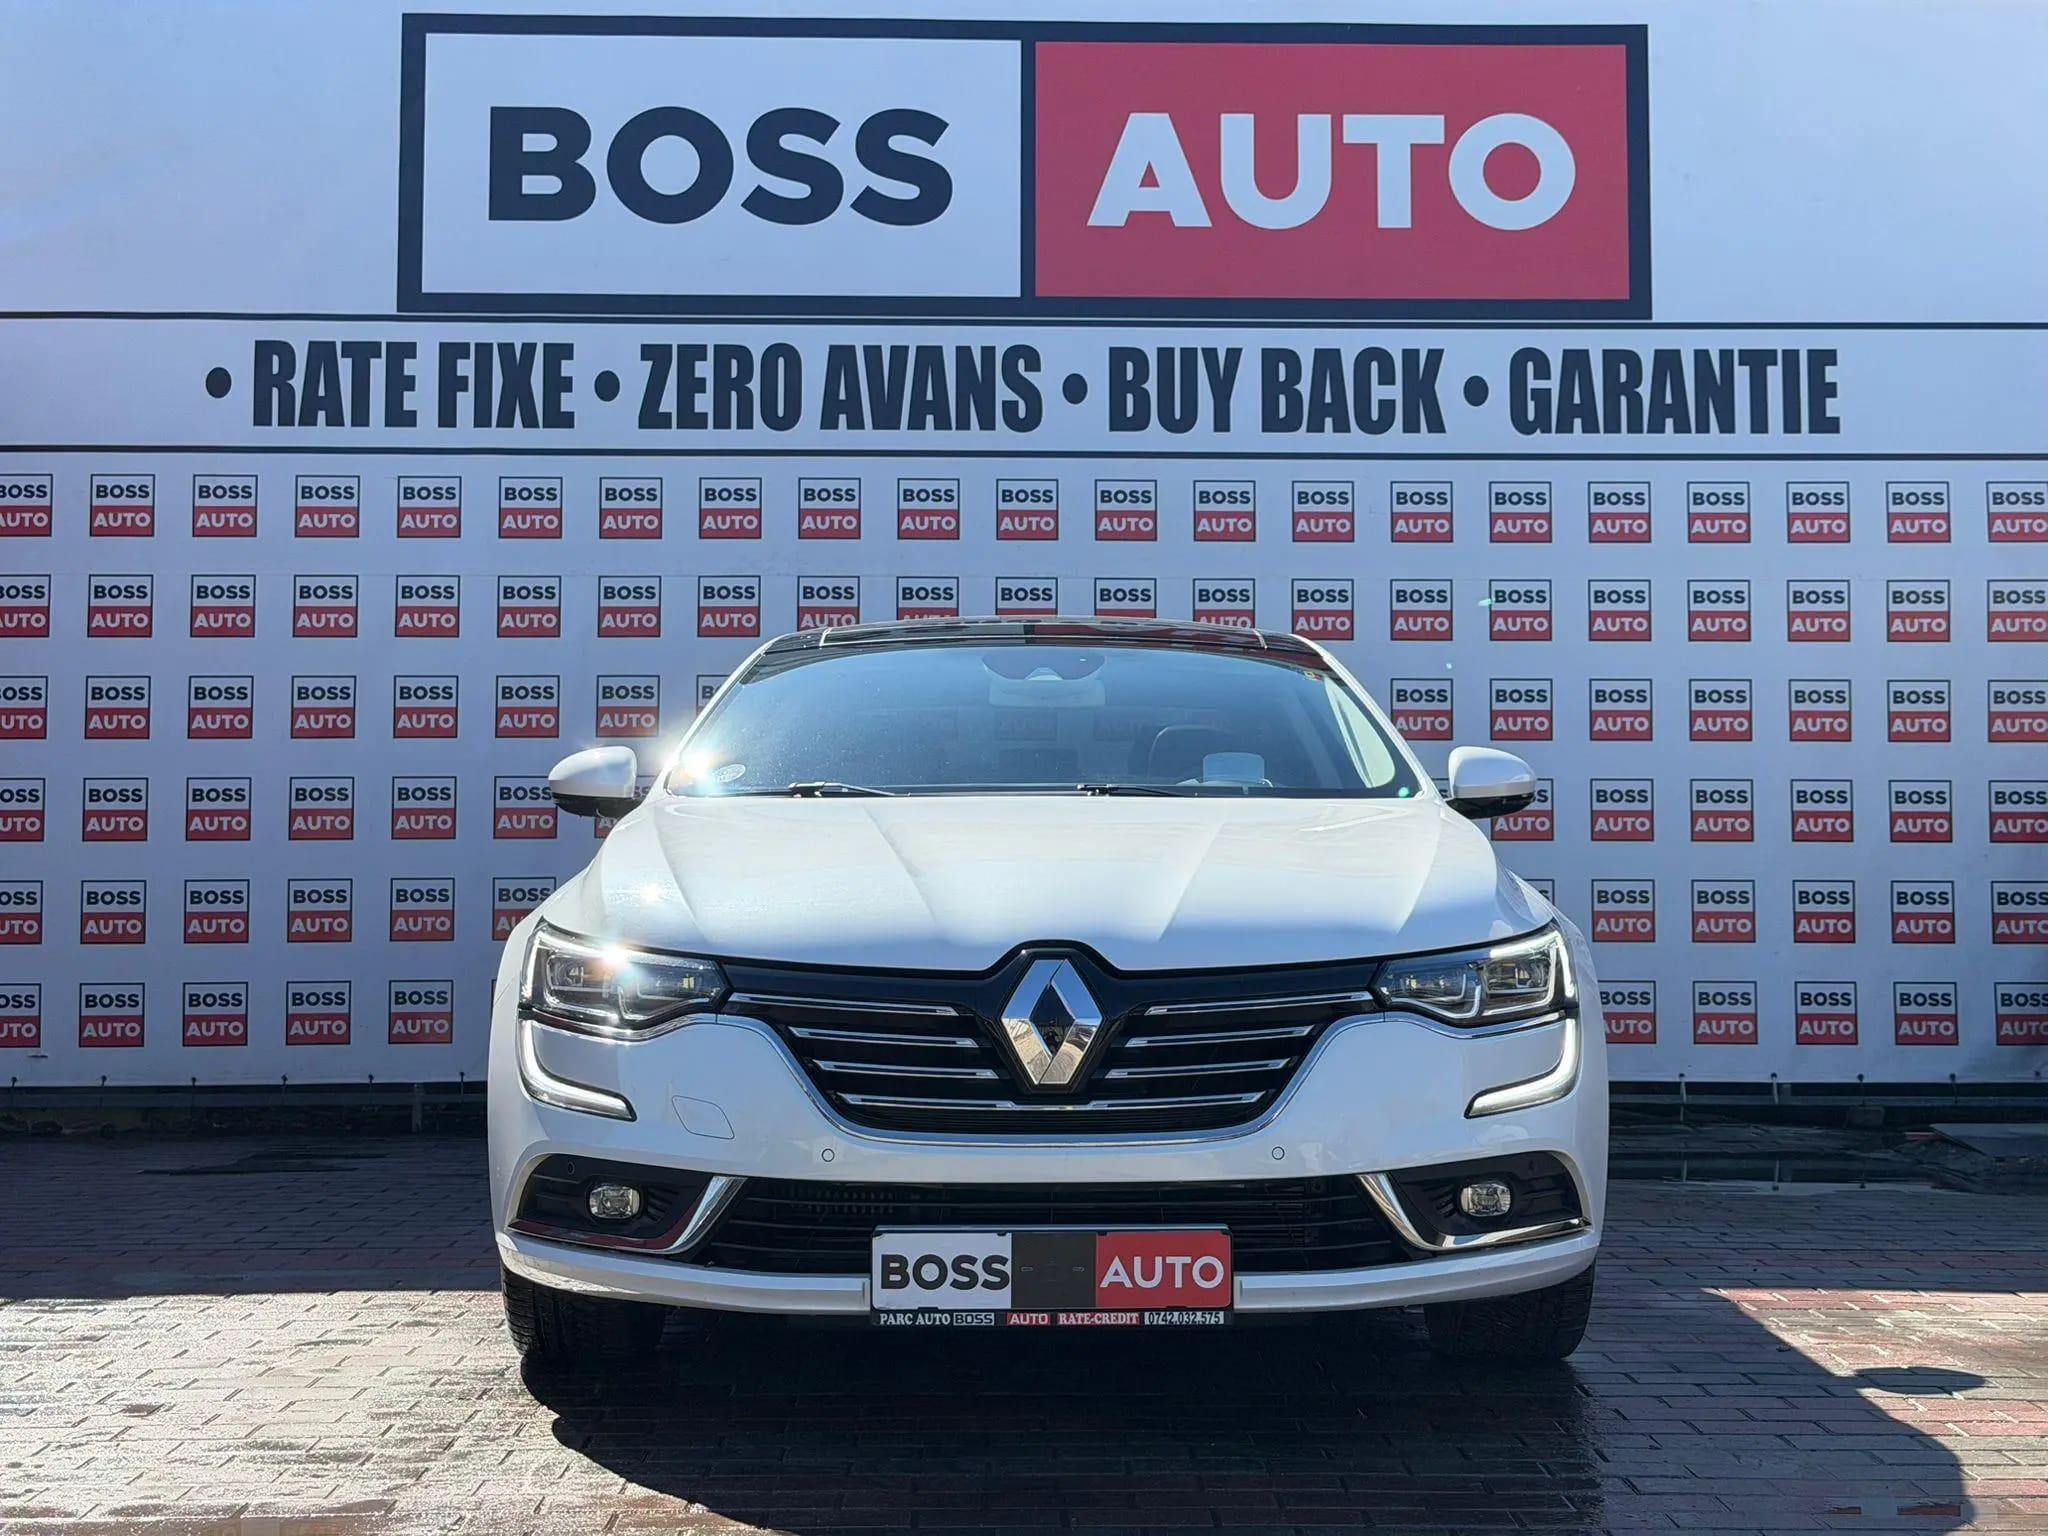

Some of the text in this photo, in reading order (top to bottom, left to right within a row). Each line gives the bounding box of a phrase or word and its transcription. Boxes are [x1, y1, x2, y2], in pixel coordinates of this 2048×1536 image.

[488, 106, 1576, 231] BOSS AUTO
[252, 340, 1842, 435] RATE FIXE ZERO AVANS BUY BACK GARANTIE
[95, 484, 150, 499] BOSS
[198, 484, 253, 500] BOSS
[403, 486, 457, 501] BOSS
[504, 486, 558, 502] BOSS
[604, 487, 658, 502] BOSS
[704, 487, 757, 502] BOSS
[803, 487, 856, 502] BOSS
[1001, 489, 1054, 504] BOSS
[1100, 489, 1153, 504] BOSS
[1198, 490, 1251, 505] BOSS
[1297, 490, 1350, 505] BOSS
[1395, 491, 1449, 506] BOSS
[1494, 491, 1547, 506] BOSS
[1593, 491, 1646, 506] BOSS
[1791, 491, 1845, 506] BOSS
[1891, 491, 1945, 506] BOSS
[1992, 491, 2046, 506] BOSS
[93, 512, 151, 527] AUTO
[196, 513, 254, 528] AUTO
[400, 514, 458, 529] AUTO
[502, 514, 559, 529] AUTO
[602, 515, 659, 530] AUTO
[702, 515, 758, 530] AUTO
[801, 515, 858, 530] AUTO
[999, 516, 1055, 531] AUTO
[1098, 517, 1154, 532] AUTO
[1197, 518, 1253, 533] AUTO
[1296, 518, 1351, 533] AUTO
[1394, 519, 1450, 534] AUTO
[1493, 519, 1549, 534] AUTO
[1592, 519, 1648, 534] AUTO
[1790, 519, 1847, 534] AUTO
[1890, 519, 1948, 534] AUTO
[93, 584, 148, 600] BOSS
[196, 584, 251, 600] BOSS
[299, 585, 353, 600] BOSS
[401, 585, 455, 600] BOSS
[603, 585, 657, 600] BOSS
[703, 585, 756, 600] BOSS
[802, 585, 855, 600] BOSS
[901, 586, 954, 601] BOSS
[1000, 587, 1053, 602] BOSS
[1099, 587, 1152, 603] BOSS
[1198, 588, 1251, 603] BOSS
[1296, 588, 1349, 603] BOSS
[1395, 589, 1448, 604] BOSS
[1494, 589, 1547, 604] BOSS
[1593, 589, 1646, 604] BOSS
[1792, 590, 1845, 605] BOSS
[1891, 590, 1945, 605] BOSS
[1992, 589, 2046, 605] BOSS
[91, 613, 149, 628] AUTO
[194, 613, 252, 628] AUTO
[296, 613, 354, 628] AUTO
[398, 613, 456, 628] AUTO
[601, 613, 657, 628] AUTO
[701, 613, 757, 628] AUTO
[1295, 616, 1351, 632] AUTO
[1394, 617, 1450, 632] AUTO
[1493, 617, 1549, 632] AUTO
[1592, 617, 1648, 632] AUTO
[1791, 617, 1847, 633] AUTO
[1890, 618, 1947, 633] AUTO
[1991, 617, 2048, 633] AUTO
[91, 686, 146, 701] BOSS
[297, 686, 351, 701] BOSS
[399, 685, 454, 700] BOSS
[501, 685, 555, 700] BOSS
[601, 685, 655, 700] BOSS
[1396, 688, 1449, 703] BOSS
[1495, 688, 1548, 703] BOSS
[1594, 689, 1648, 704] BOSS
[1694, 689, 1747, 704] BOSS
[1794, 689, 1847, 704] BOSS
[1892, 690, 1946, 705] BOSS
[1993, 690, 2047, 705] BOSS
[88, 714, 147, 730] AUTO
[294, 714, 352, 729] AUTO
[397, 713, 455, 729] AUTO
[498, 713, 556, 729] AUTO
[599, 713, 656, 729] AUTO
[1493, 716, 1550, 732] AUTO
[1593, 716, 1649, 732] AUTO
[1692, 717, 1749, 732] AUTO
[1792, 717, 1849, 732] AUTO
[1891, 718, 1948, 733] AUTO
[88, 788, 143, 803] BOSS
[191, 787, 246, 803] BOSS
[294, 787, 349, 802] BOSS
[397, 786, 452, 802] BOSS
[1595, 789, 1649, 804] BOSS
[1695, 789, 1749, 804] BOSS
[1796, 789, 1848, 804] BOSS
[1894, 790, 1947, 805] BOSS
[1994, 790, 2048, 805] BOSS
[86, 816, 144, 832] AUTO
[189, 816, 247, 831] AUTO
[292, 815, 351, 831] AUTO
[394, 815, 453, 830] AUTO
[497, 814, 554, 829] AUTO
[1494, 816, 1551, 832] AUTO
[1594, 817, 1651, 832] AUTO
[1694, 817, 1751, 832] AUTO
[1795, 817, 1850, 833] AUTO
[1893, 818, 1949, 833] AUTO
[86, 890, 141, 906] BOSS
[189, 889, 245, 905] BOSS
[395, 888, 450, 903] BOSS
[1597, 889, 1650, 904] BOSS
[1696, 890, 1750, 905] BOSS
[1798, 890, 1850, 905] BOSS
[1896, 891, 1950, 906] BOSS
[84, 919, 142, 935] AUTO
[187, 918, 245, 934] AUTO
[393, 916, 451, 932] AUTO
[1595, 918, 1652, 933] AUTO
[1695, 918, 1752, 933] AUTO
[1797, 918, 1852, 934] AUTO
[1895, 919, 1952, 934] AUTO
[84, 993, 140, 1009] BOSS
[188, 992, 243, 1008] BOSS
[291, 991, 346, 1007] BOSS
[394, 990, 449, 1006] BOSS
[1698, 991, 1752, 1007] BOSS
[1800, 991, 1852, 1007] BOSS
[1899, 992, 1953, 1007] BOSS
[82, 1022, 141, 1038] AUTO
[186, 1021, 244, 1037] AUTO
[289, 1020, 347, 1036] AUTO
[392, 1019, 450, 1034] AUTO
[1696, 1020, 1754, 1035] AUTO
[1799, 1020, 1855, 1035] AUTO
[1898, 1021, 1955, 1036] AUTO
[880, 1254, 1225, 1290] BOSS AUTO
[879, 1311, 1222, 1326] PARC AUTO BOSS AUTO RATE-CREDIT 0742.032.575
